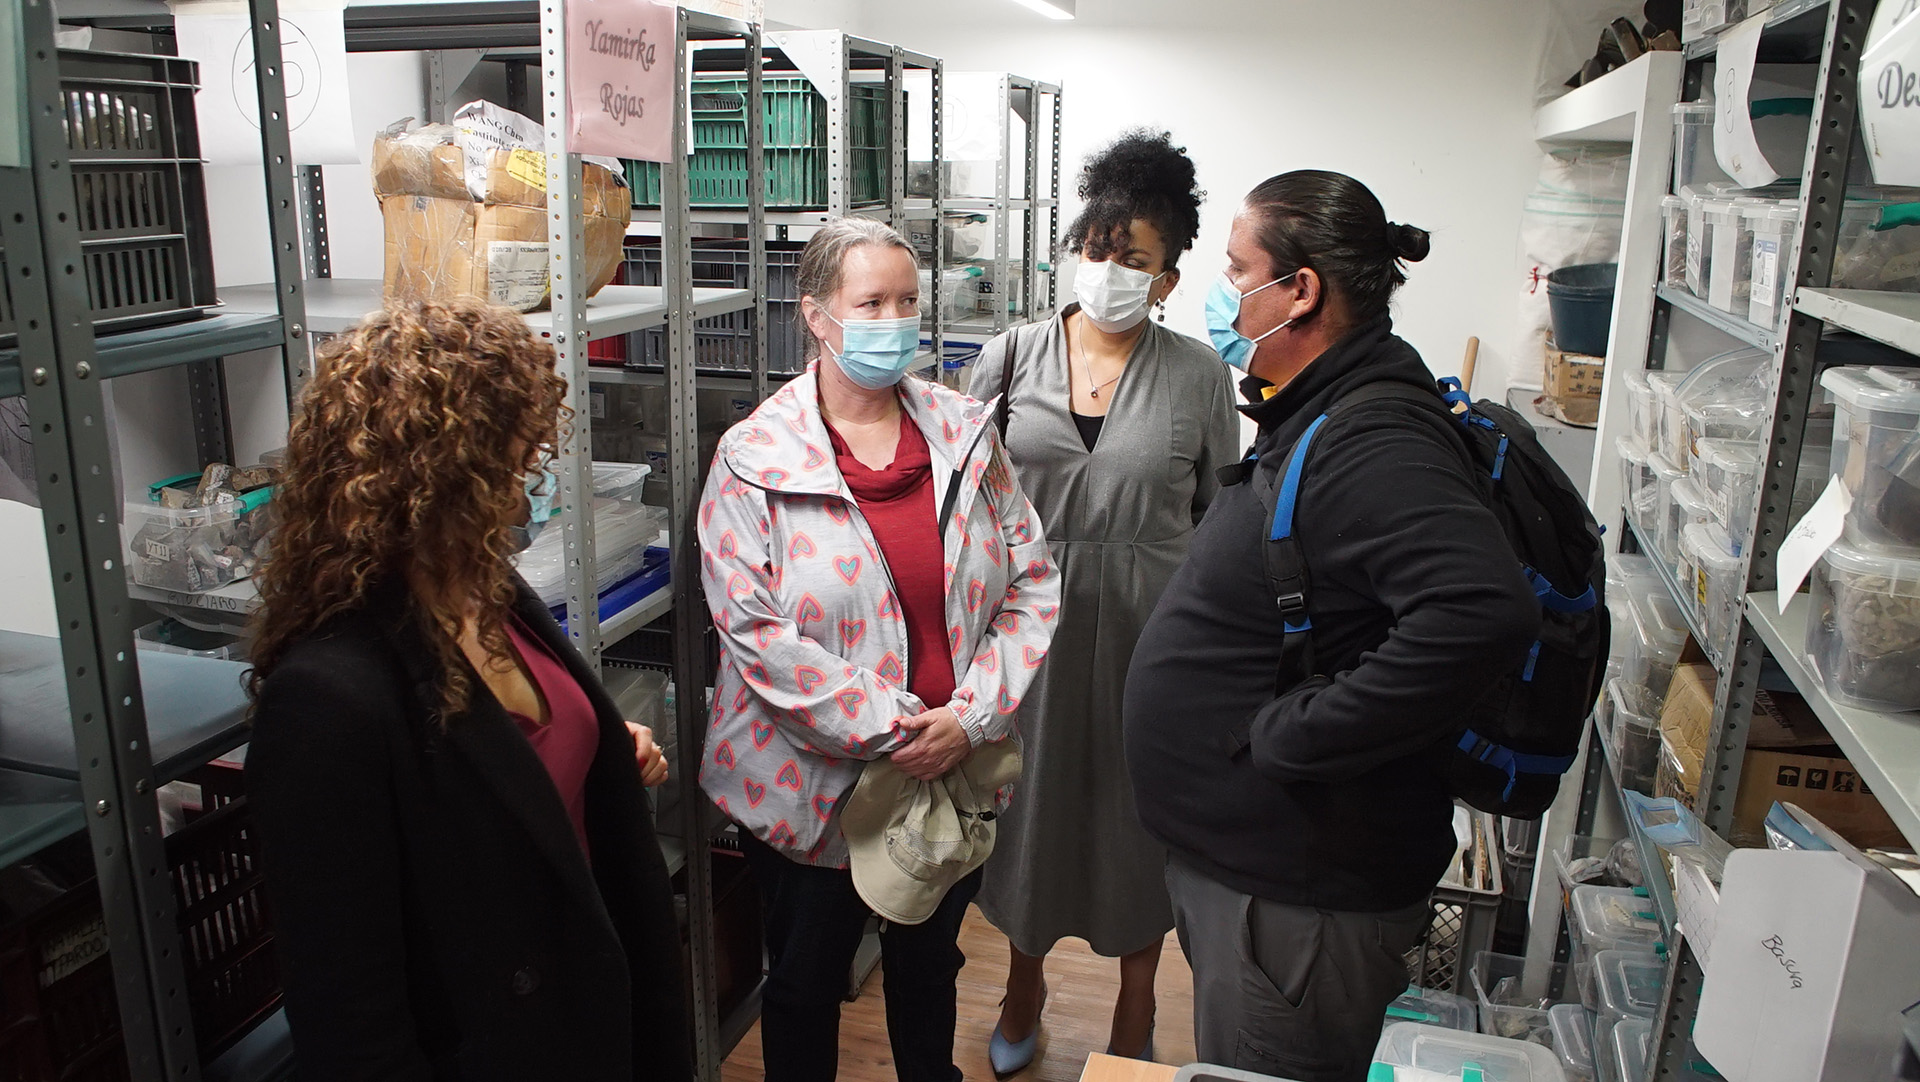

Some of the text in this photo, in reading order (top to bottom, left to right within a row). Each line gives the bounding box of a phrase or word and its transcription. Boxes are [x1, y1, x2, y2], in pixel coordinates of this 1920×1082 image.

[585, 19, 656, 72] Yamirka
[600, 82, 645, 127] Rojas
[1877, 61, 1920, 109] De
[466, 111, 524, 143] WANG Chen
[468, 126, 506, 148] nstitute
